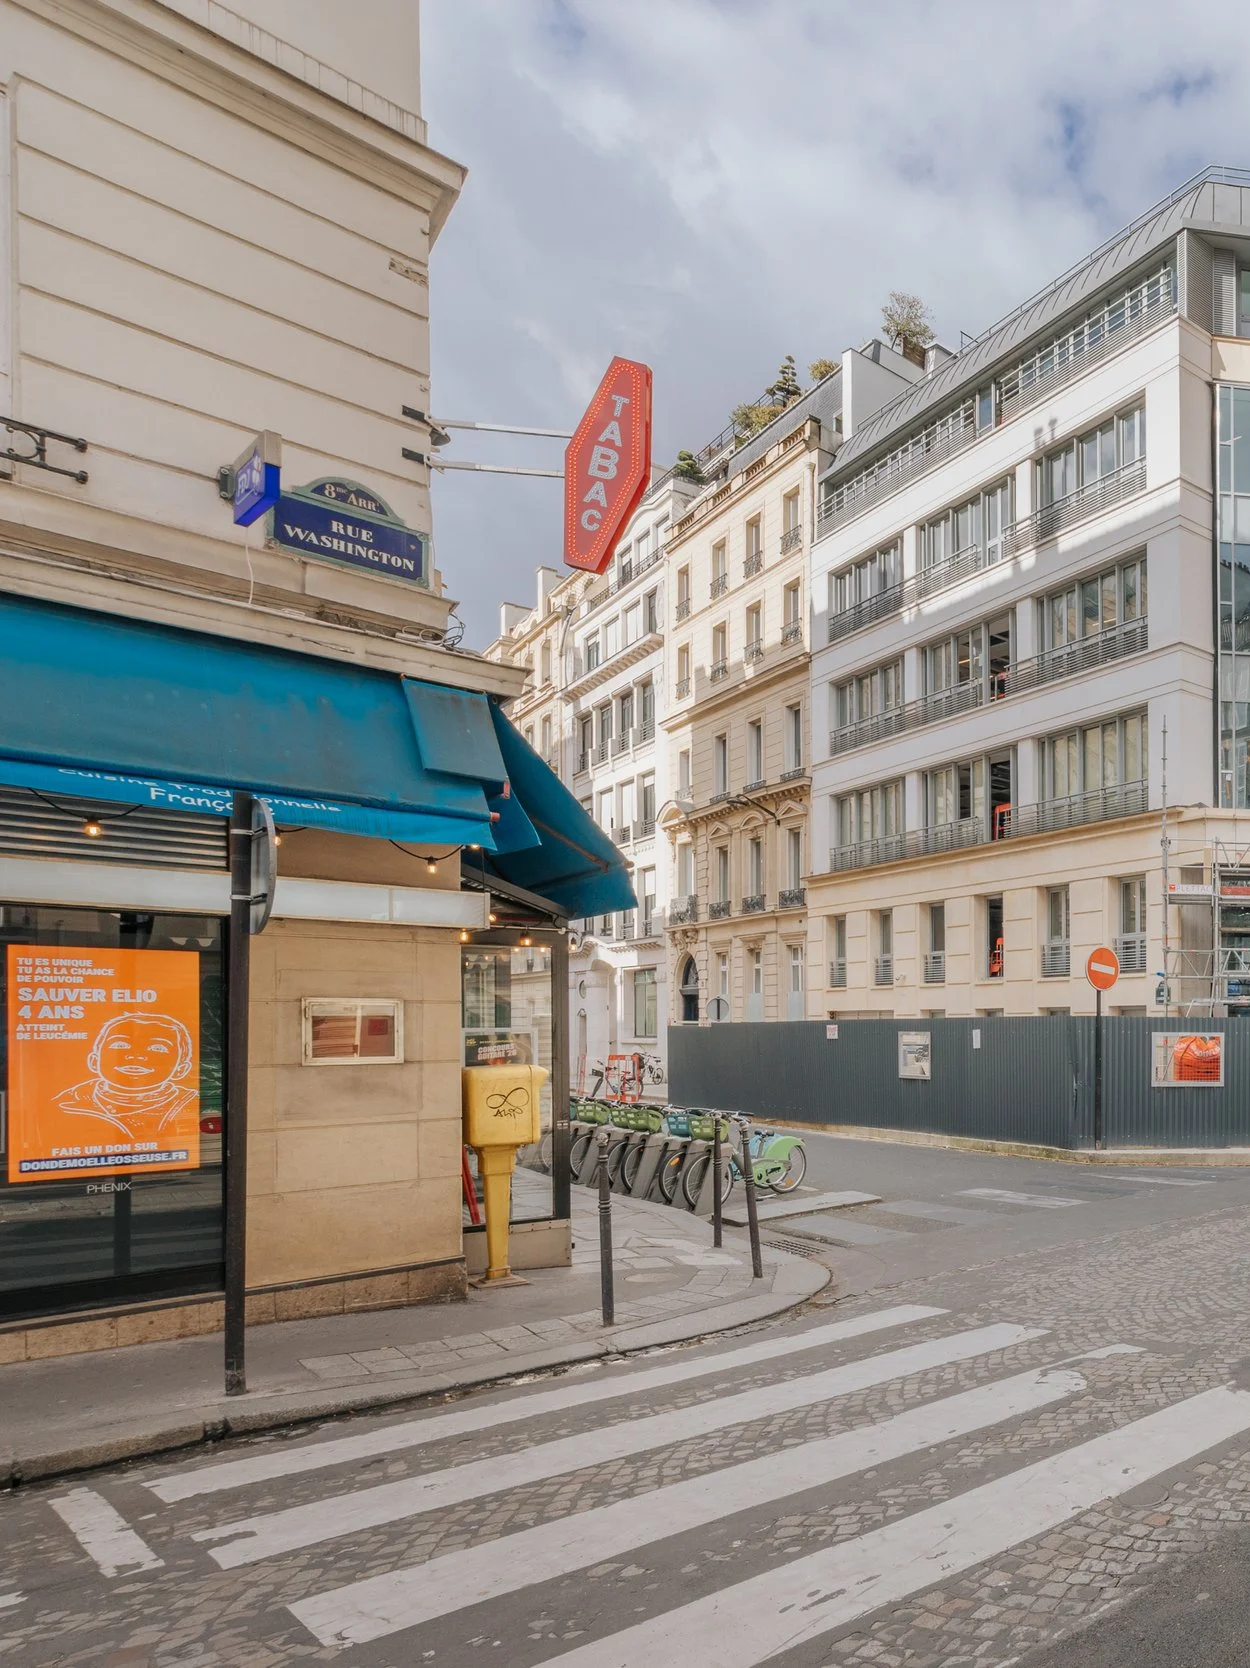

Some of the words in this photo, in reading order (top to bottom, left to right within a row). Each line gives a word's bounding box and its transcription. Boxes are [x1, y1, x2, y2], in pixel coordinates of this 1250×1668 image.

[581, 394, 630, 532] TABAC
[331, 519, 374, 543] RUE
[283, 524, 415, 572] WASHINGTON
[58, 768, 158, 787] Cuisine
[16, 957, 33, 965] TU
[35, 957, 50, 966] ES
[52, 958, 93, 967] UNIQUE
[16, 966, 33, 974] TU
[35, 966, 51, 975] AS
[53, 967, 68, 975] LA
[70, 967, 115, 976] CHANCE
[16, 975, 32, 983] DE
[34, 975, 84, 984] POUVOIR
[17, 988, 106, 1002] SAUVER
[112, 989, 157, 1003] ELIO
[18, 1005, 32, 1019] 4
[37, 1005, 85, 1019] ANS
[16, 1023, 65, 1031] ATTEINT
[16, 1032, 31, 1040] DE
[33, 1031, 88, 1040] LEUCÉMIE
[52, 1146, 81, 1156] FAIS
[84, 1145, 103, 1154] UN
[105, 1143, 131, 1153] DON
[134, 1142, 158, 1151] SUR
[20, 1151, 187, 1172] DONDEMOELLEOSSEUSE.FR
[86, 1182, 132, 1194] PHENIX
